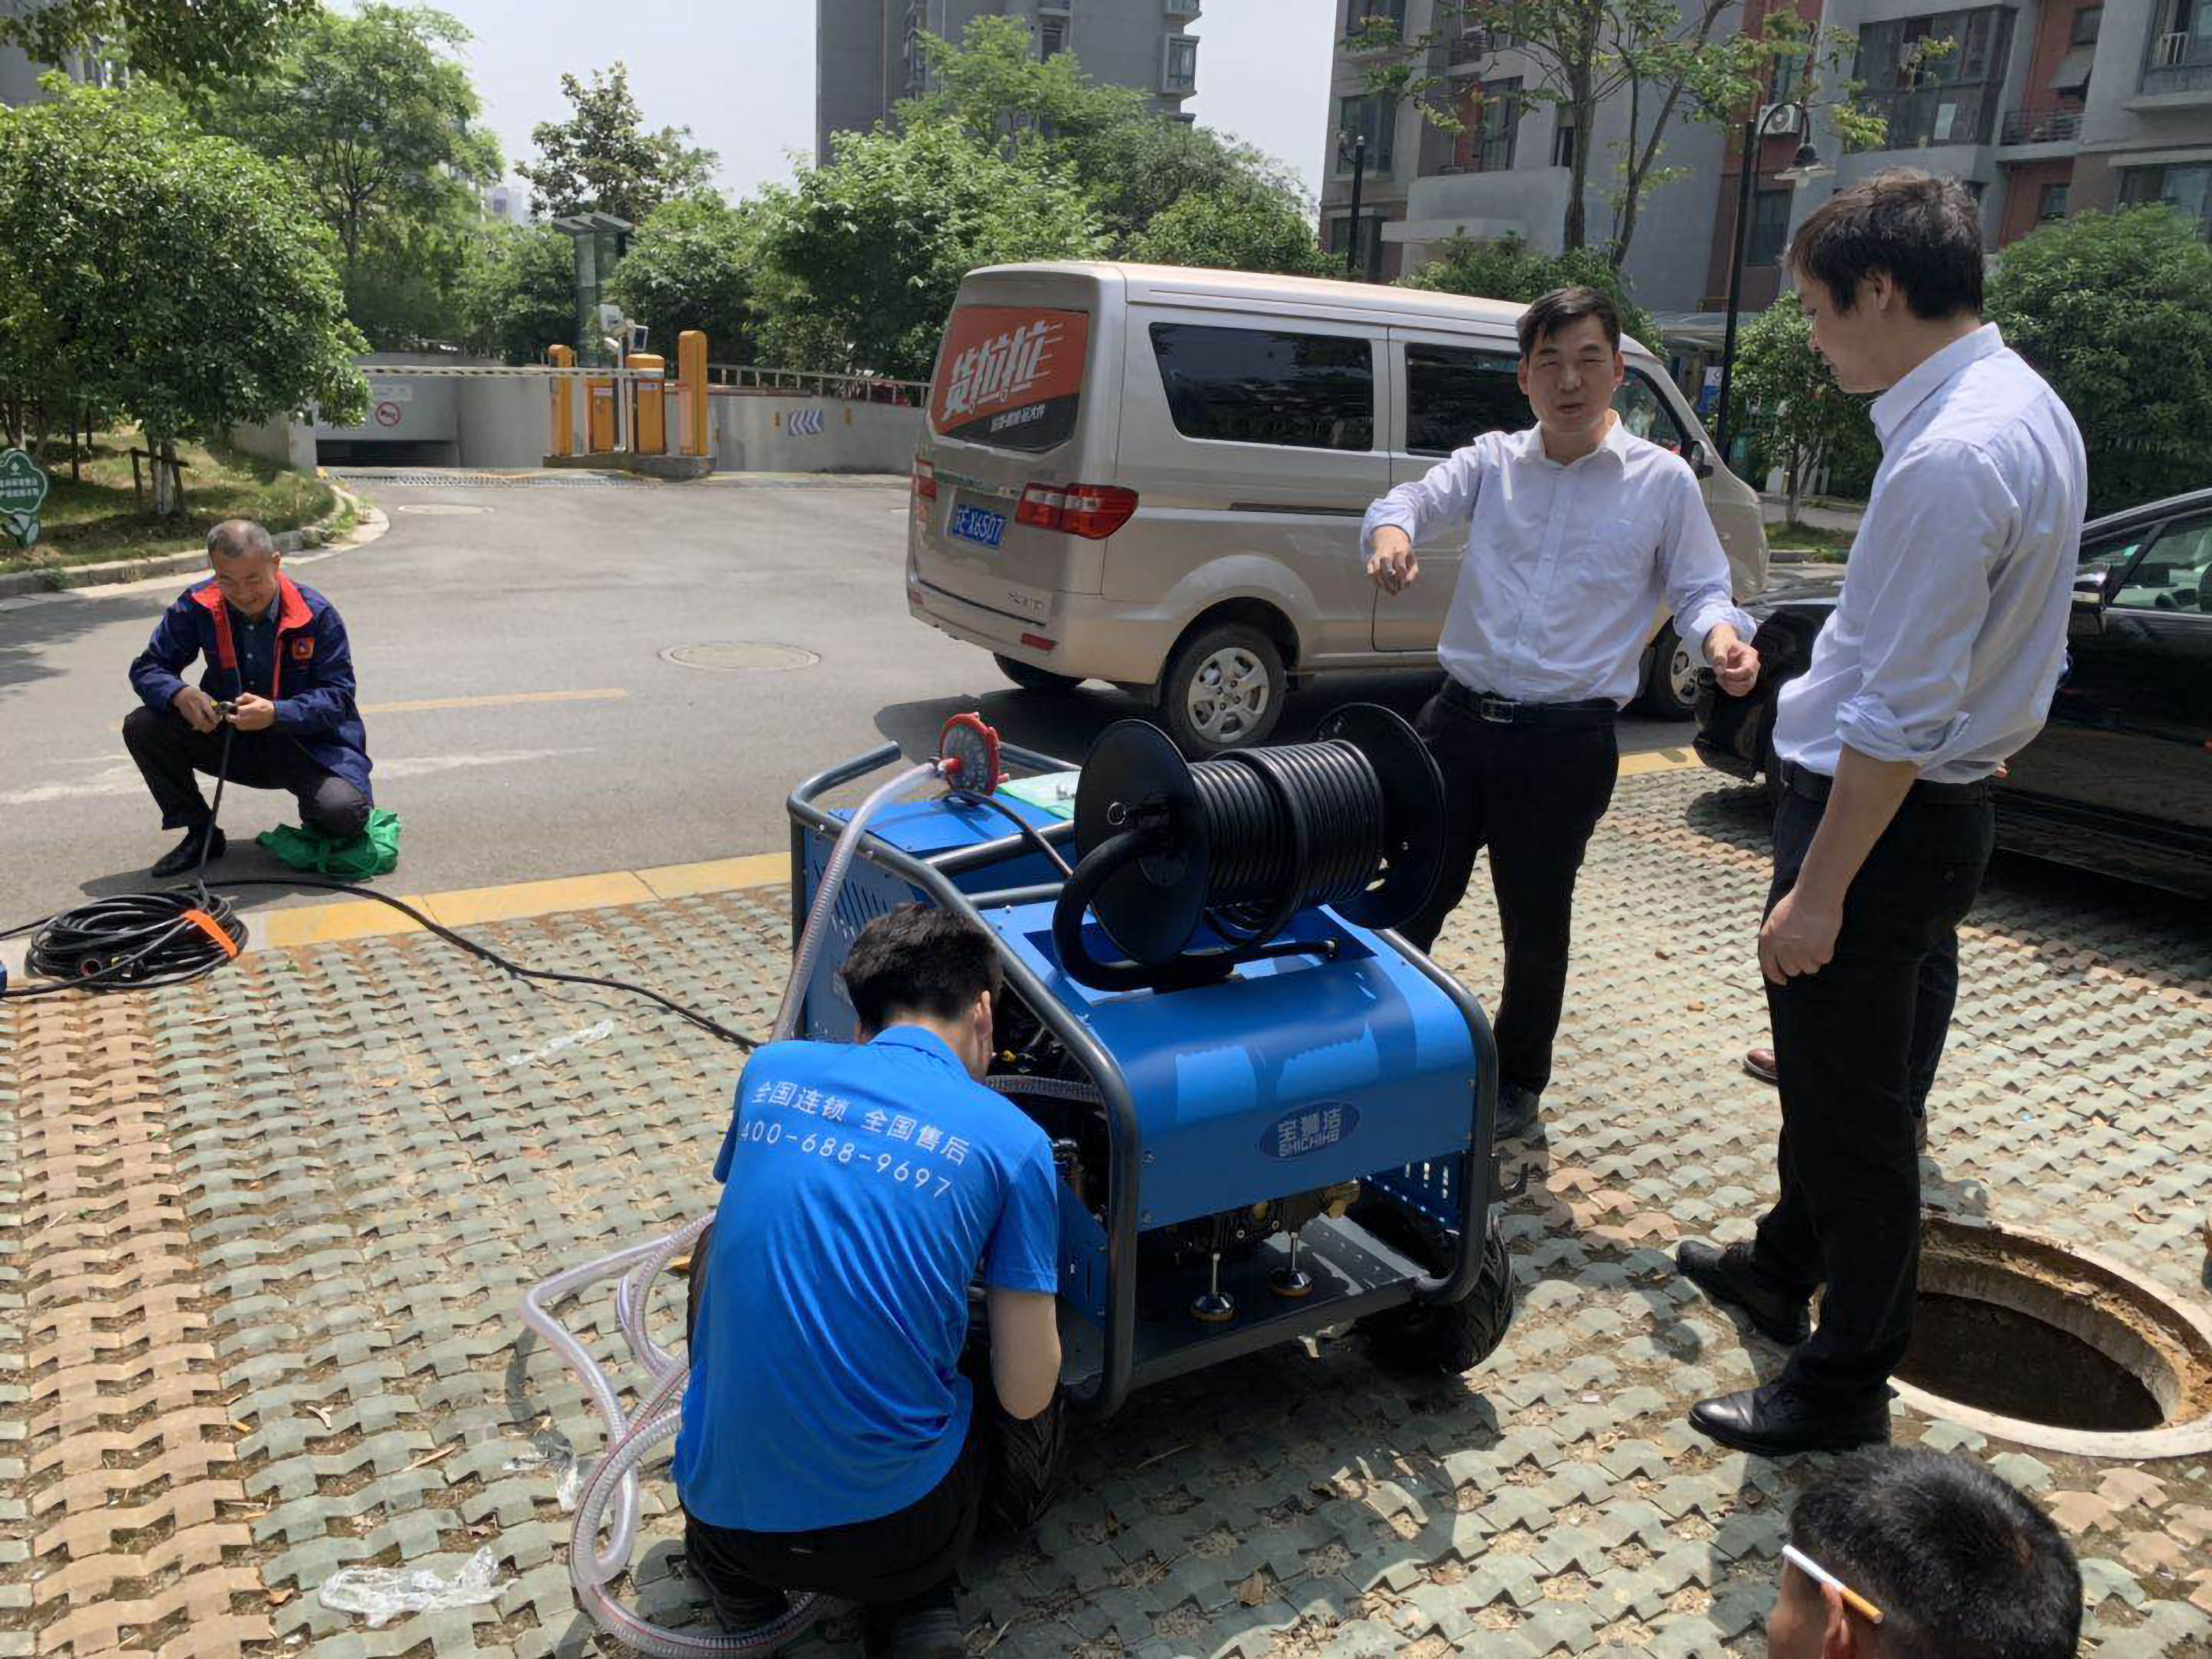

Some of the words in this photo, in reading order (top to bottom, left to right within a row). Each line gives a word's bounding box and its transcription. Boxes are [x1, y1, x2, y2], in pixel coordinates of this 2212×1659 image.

[740, 1120, 951, 1198] 400-688-9697
[751, 1081, 851, 1121] 全国连锁
[861, 1108, 972, 1166] 全国售后
